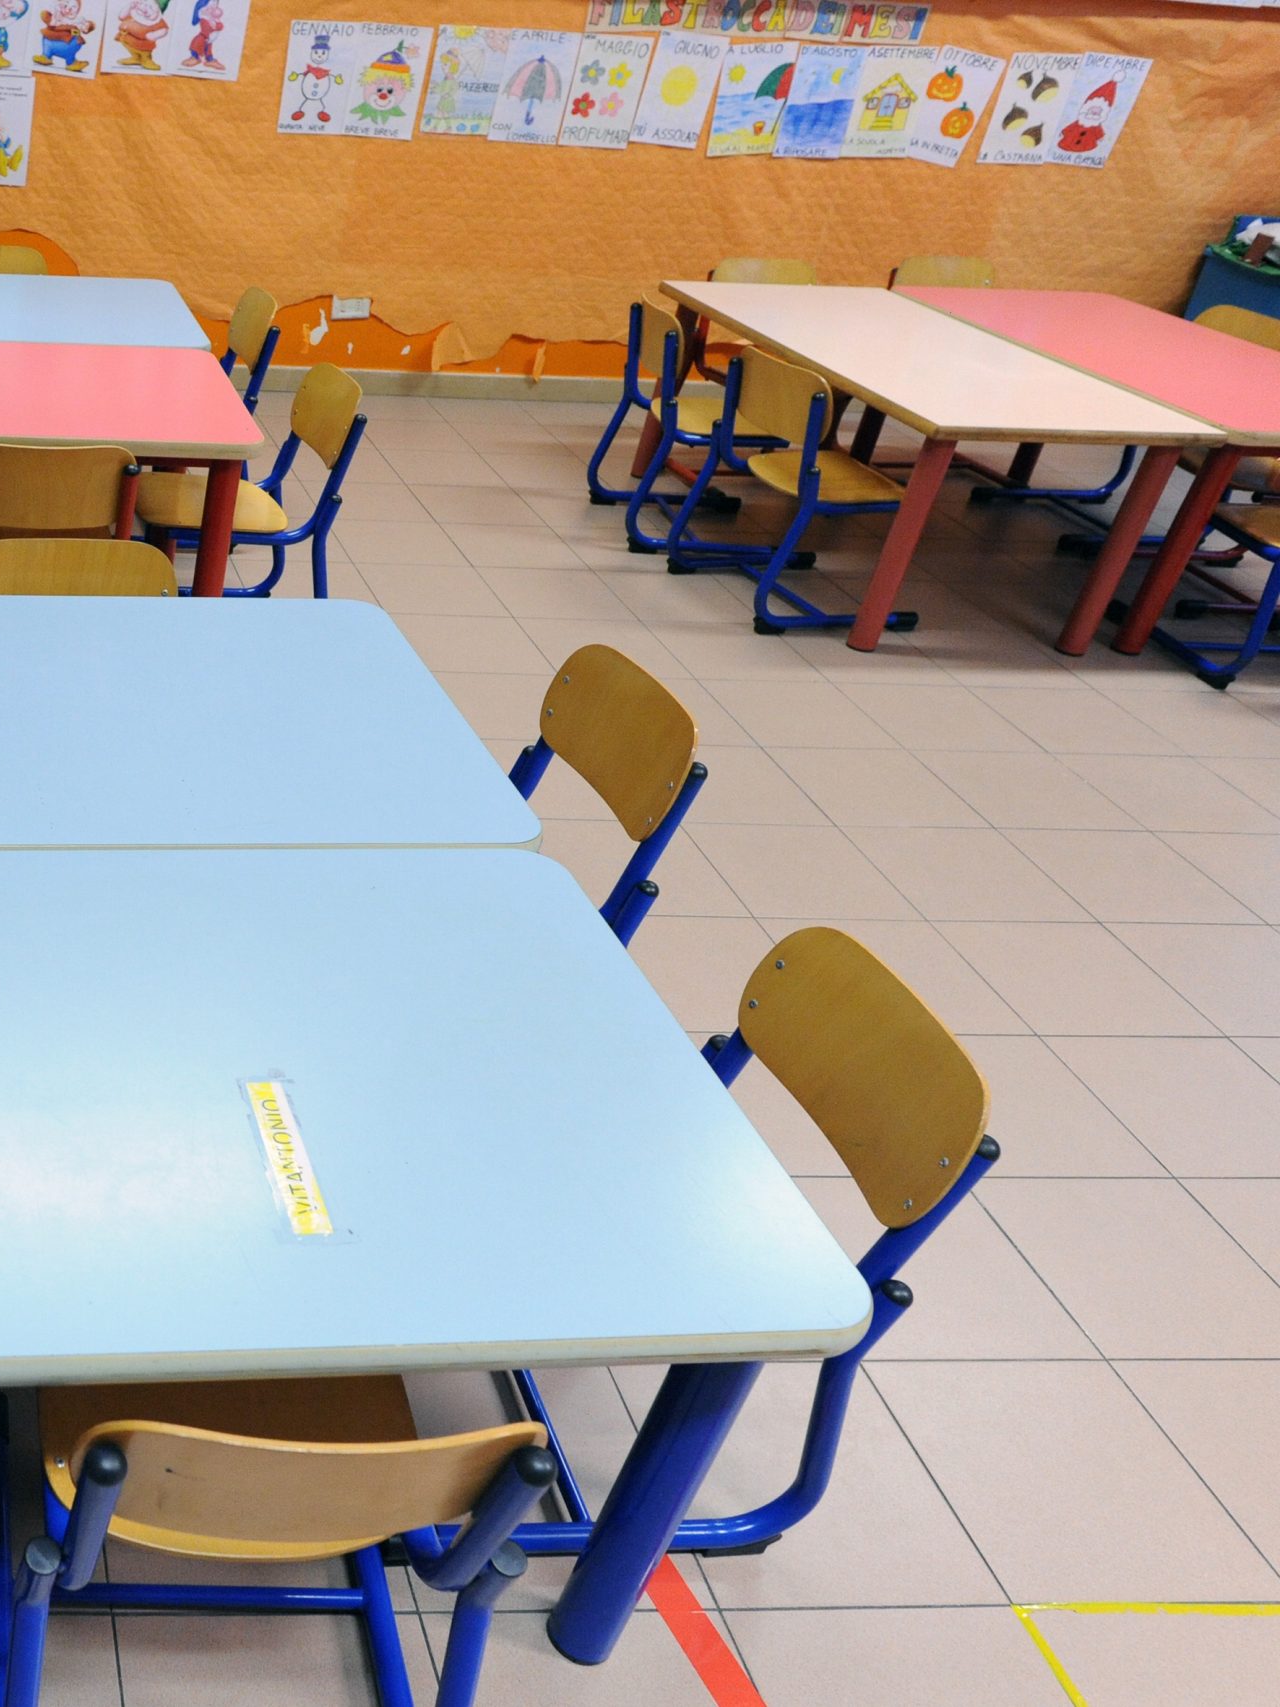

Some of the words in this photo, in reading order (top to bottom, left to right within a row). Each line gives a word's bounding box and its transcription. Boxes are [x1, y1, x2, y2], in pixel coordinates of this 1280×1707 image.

[291, 22, 355, 37] GENNAIO
[361, 23, 420, 37] FEBBRAIO
[843, 5, 928, 41] MESI
[521, 31, 567, 44] APRILE
[594, 39, 650, 59] MAGGIO
[674, 40, 720, 59] GIUGNO
[740, 44, 784, 56] LUGLIO
[943, 47, 999, 71] OTTOBRE
[1011, 55, 1080, 71] NOVEMBRE
[1084, 54, 1148, 72] DICEMBRE
[344, 125, 370, 135] BREVE
[373, 127, 400, 138] BREVE
[491, 123, 513, 131] CON
